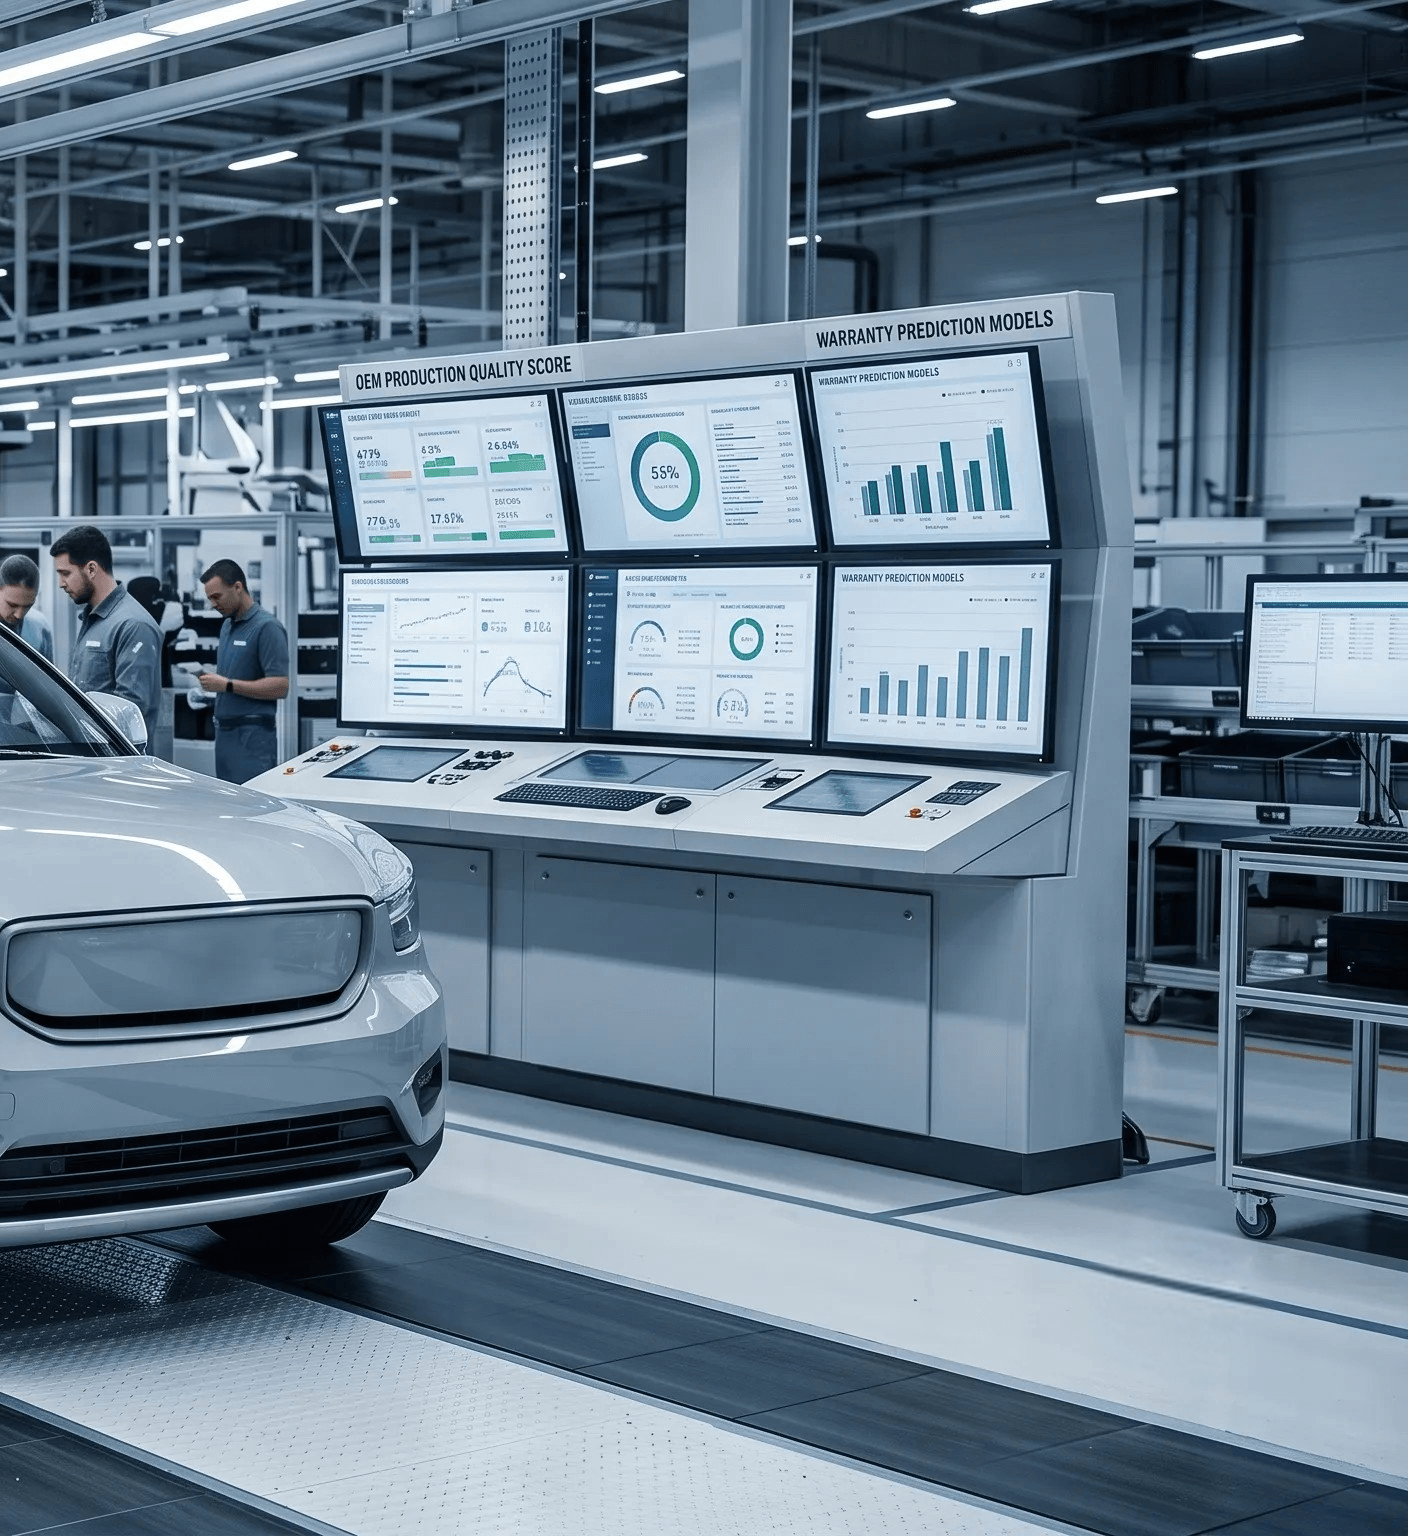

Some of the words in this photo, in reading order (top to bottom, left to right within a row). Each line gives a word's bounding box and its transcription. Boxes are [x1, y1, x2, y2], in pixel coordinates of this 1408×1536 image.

[815, 325, 894, 349] WARRANTY
[897, 316, 986, 341] PREDICTION
[989, 309, 1054, 332] MODELS
[355, 372, 382, 391] OEM
[385, 365, 466, 388] PRODUCTION
[469, 359, 524, 383] QUALITY
[527, 355, 572, 376] SCORE
[859, 371, 906, 383] PREDICTION
[841, 573, 883, 583] WARRANTY
